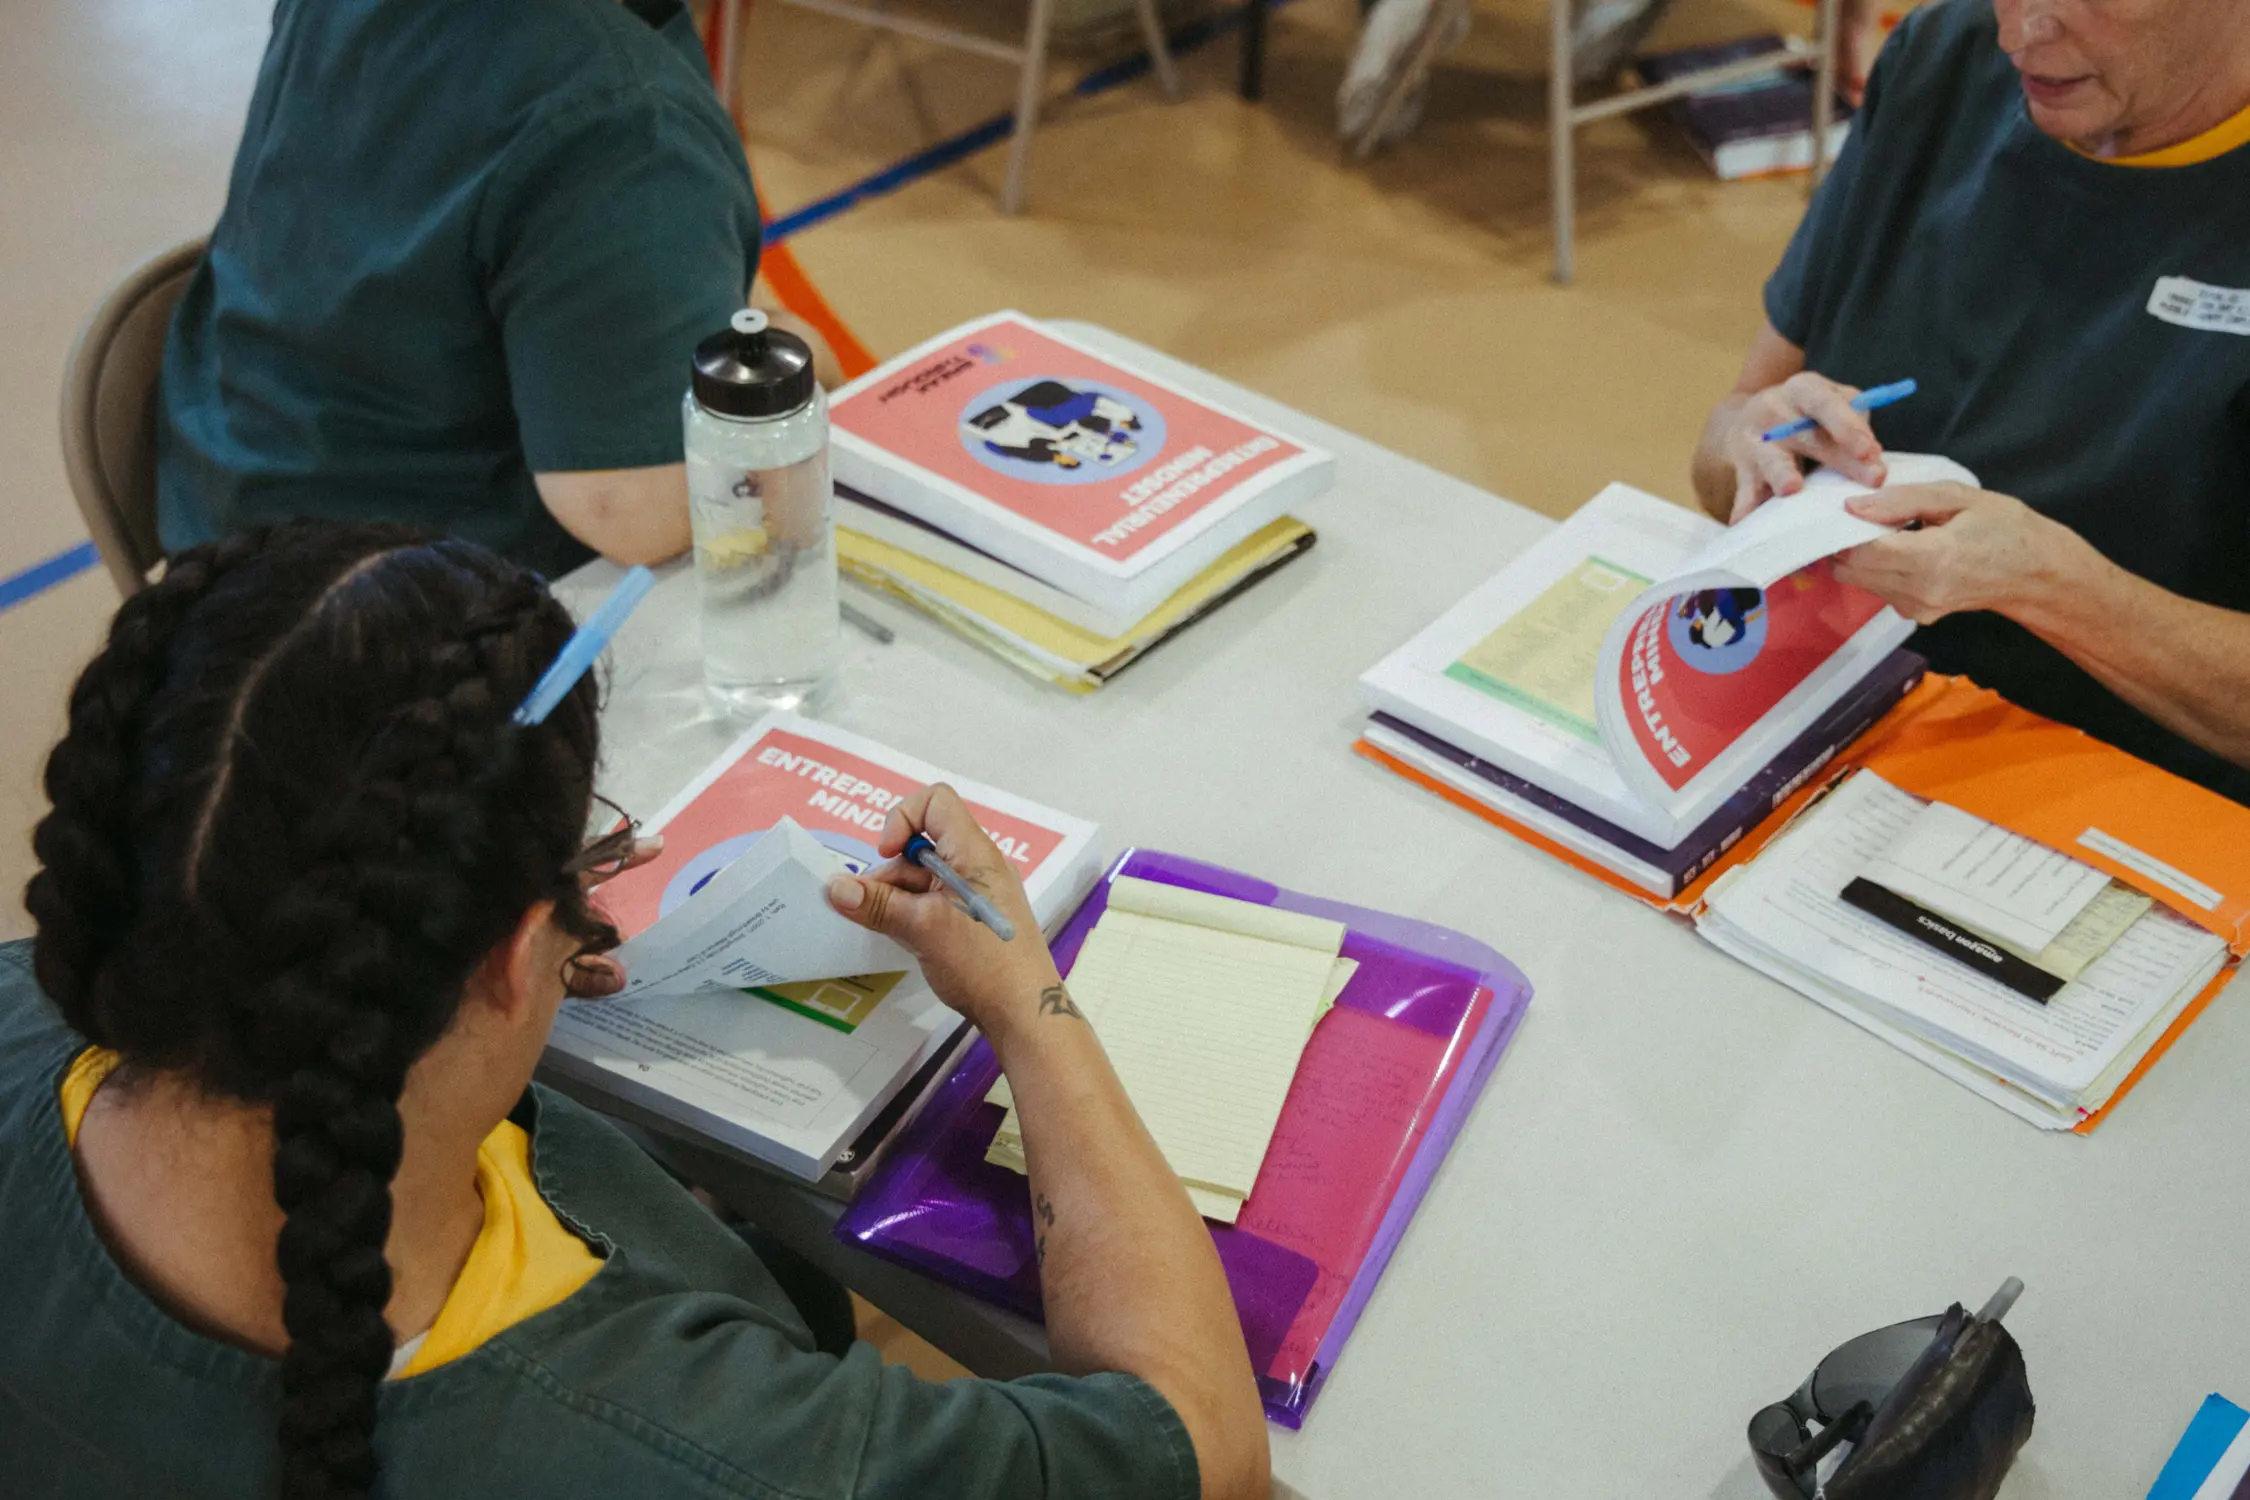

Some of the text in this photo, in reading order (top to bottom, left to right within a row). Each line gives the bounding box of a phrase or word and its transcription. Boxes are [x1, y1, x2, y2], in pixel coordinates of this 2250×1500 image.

[1091, 435, 1281, 546] ENTREPRENEURIAL
[1119, 445, 1213, 507] MINDSET
[1917, 916, 2003, 963] amazon basics
